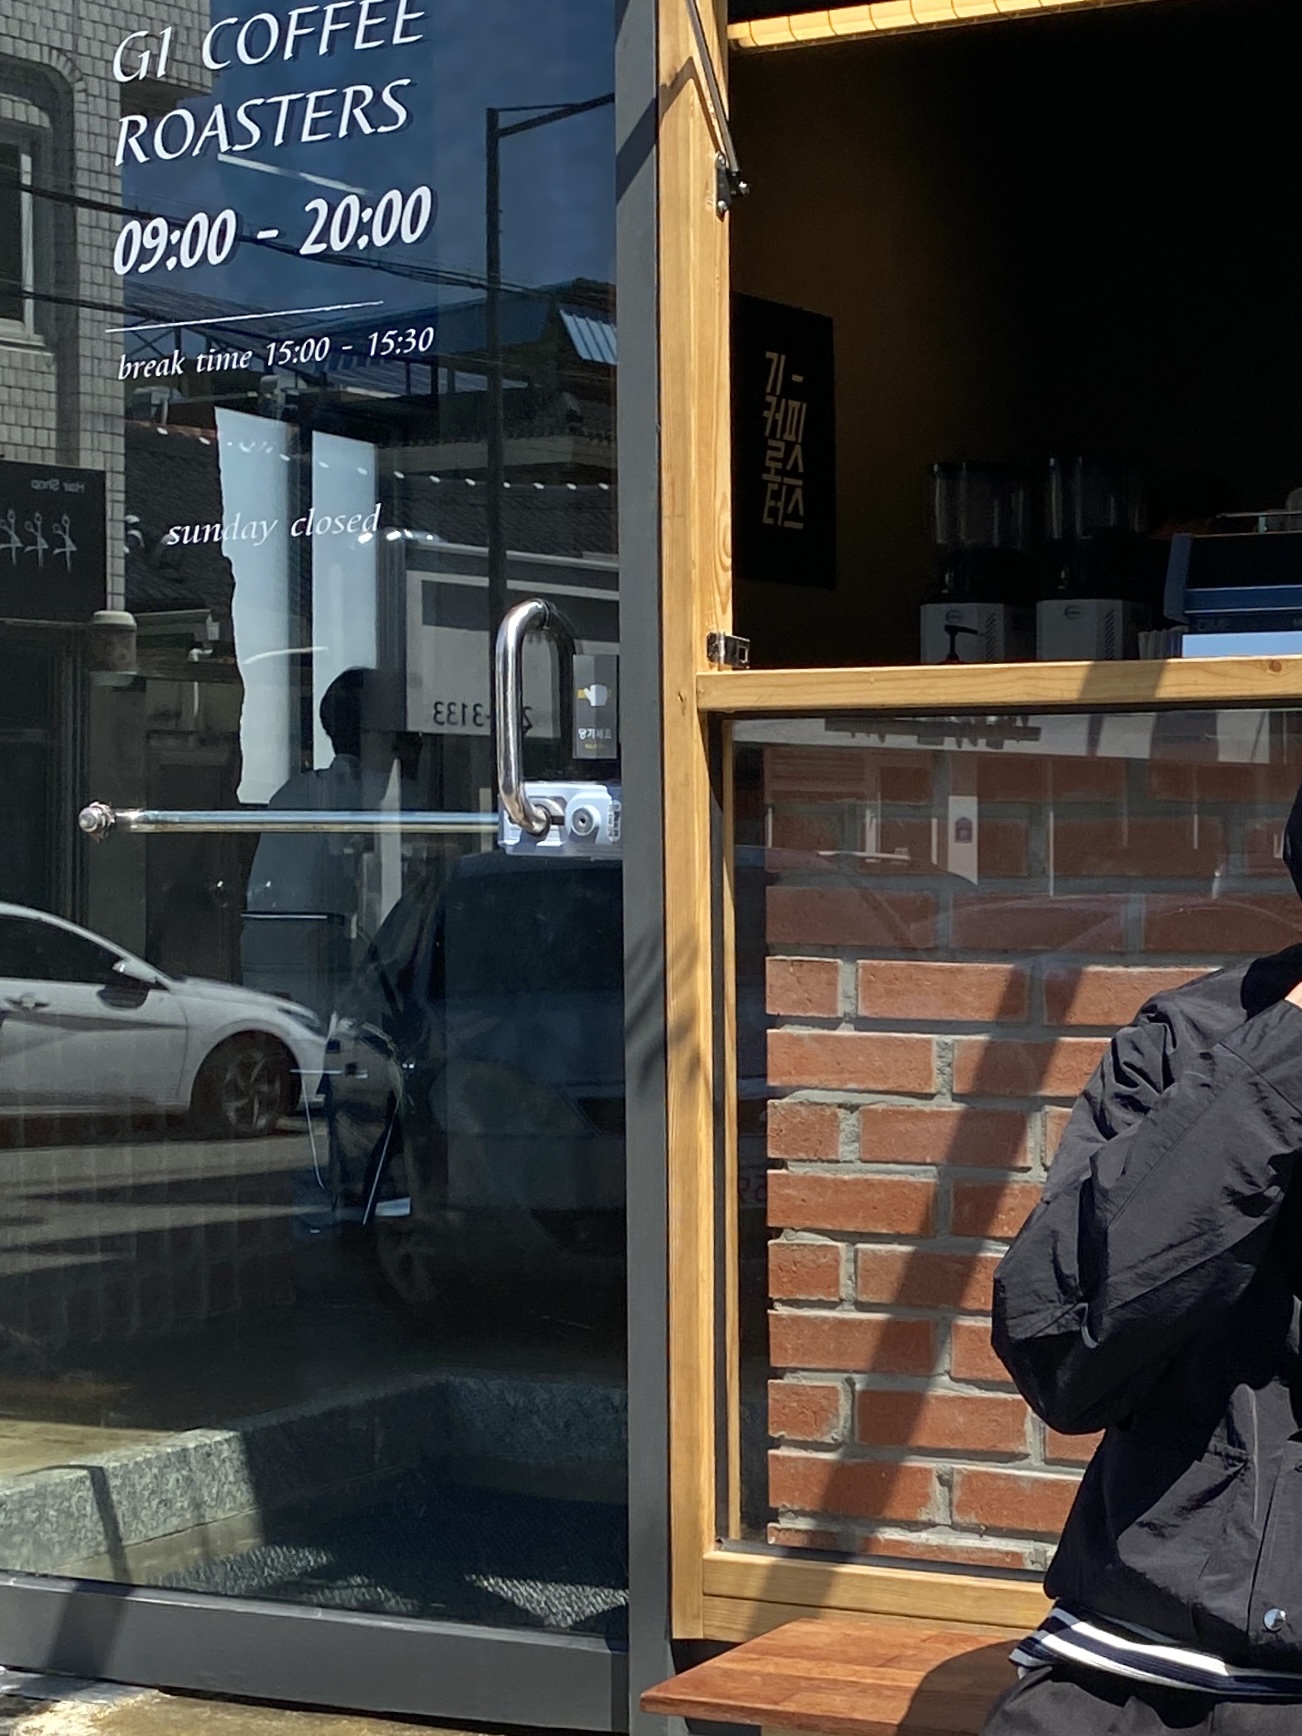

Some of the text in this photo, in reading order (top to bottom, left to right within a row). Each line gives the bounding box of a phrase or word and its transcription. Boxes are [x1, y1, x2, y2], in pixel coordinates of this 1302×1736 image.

[202, 0, 426, 71] COFFEE
[114, 79, 411, 167] ROASTERS
[113, 209, 237, 275] 09:00
[299, 185, 433, 256] 20:00
[117, 351, 184, 381] break
[196, 345, 252, 376] time
[266, 337, 331, 367] 15:00
[368, 326, 434, 357] 15:30
[167, 503, 382, 546] sunday closed
